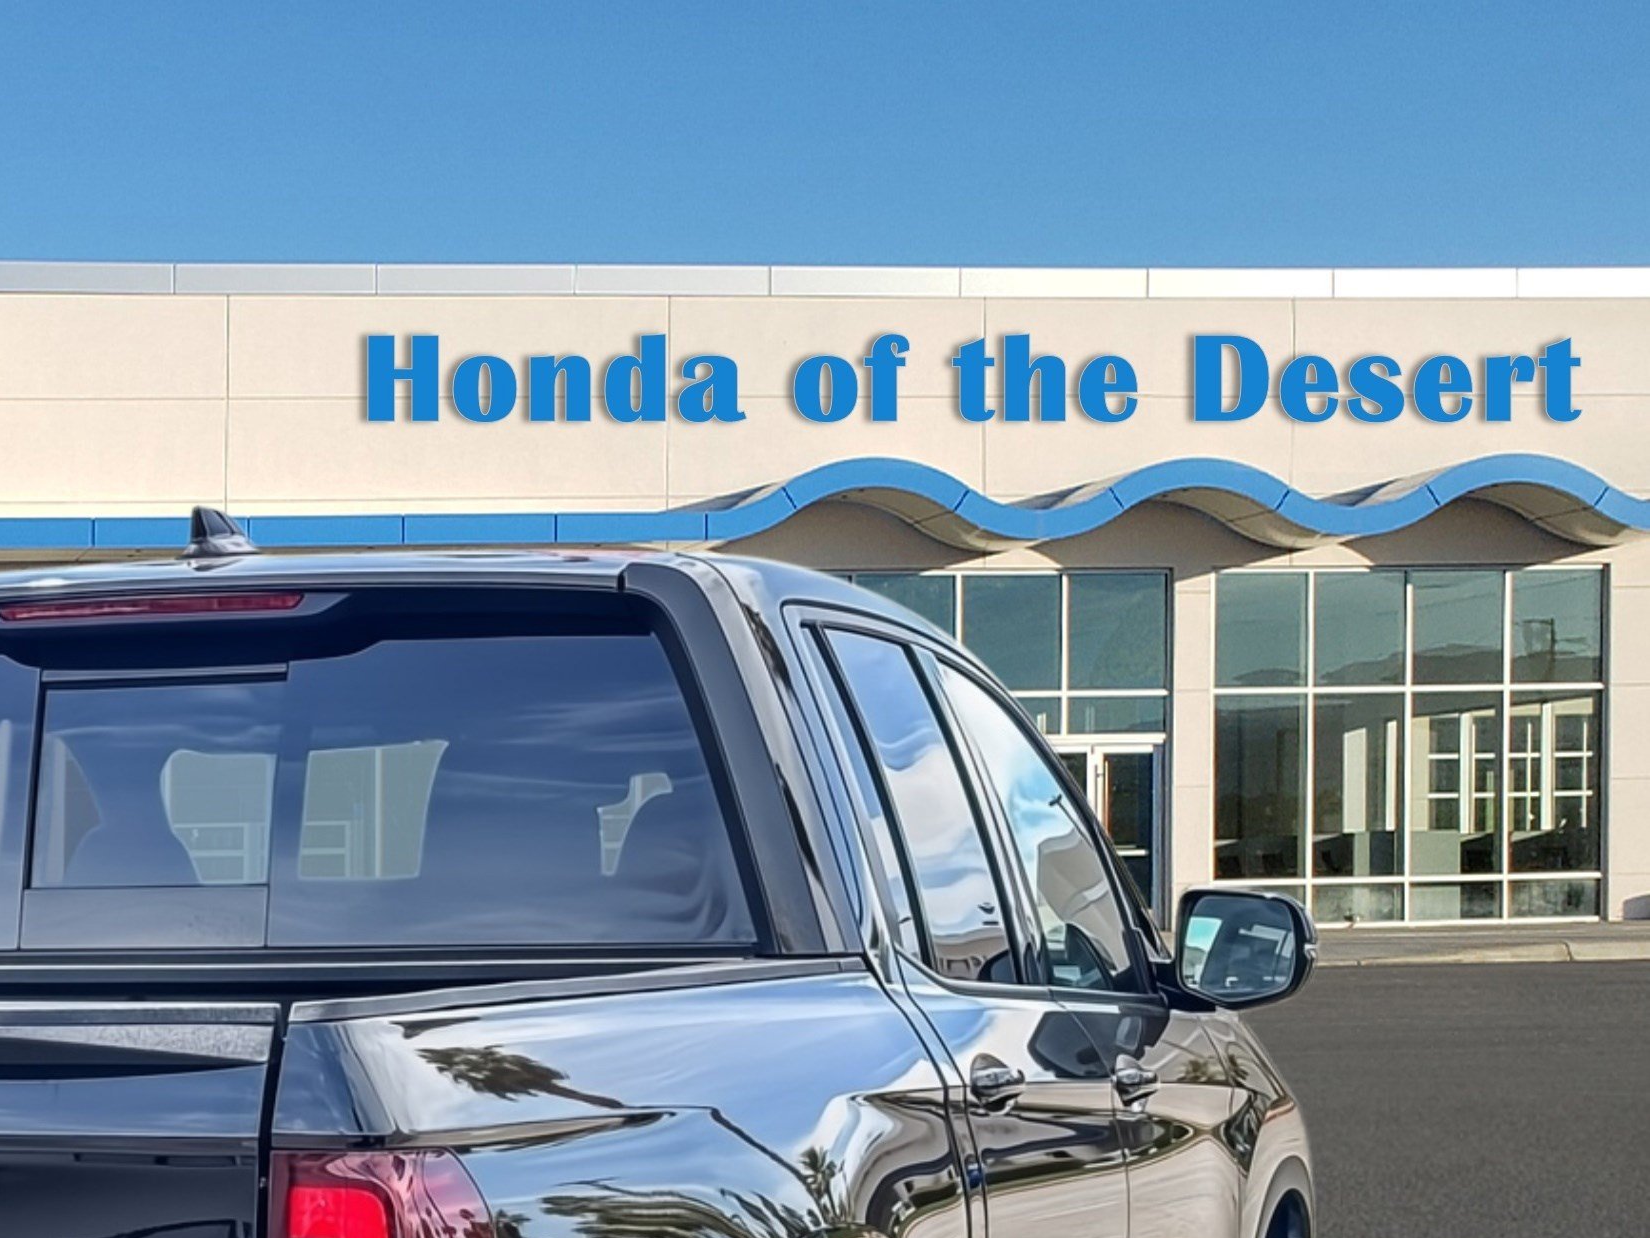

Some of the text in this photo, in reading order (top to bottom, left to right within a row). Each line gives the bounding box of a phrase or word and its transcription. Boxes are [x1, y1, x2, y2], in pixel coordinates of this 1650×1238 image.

[364, 332, 1583, 424] Honda of the Desert
